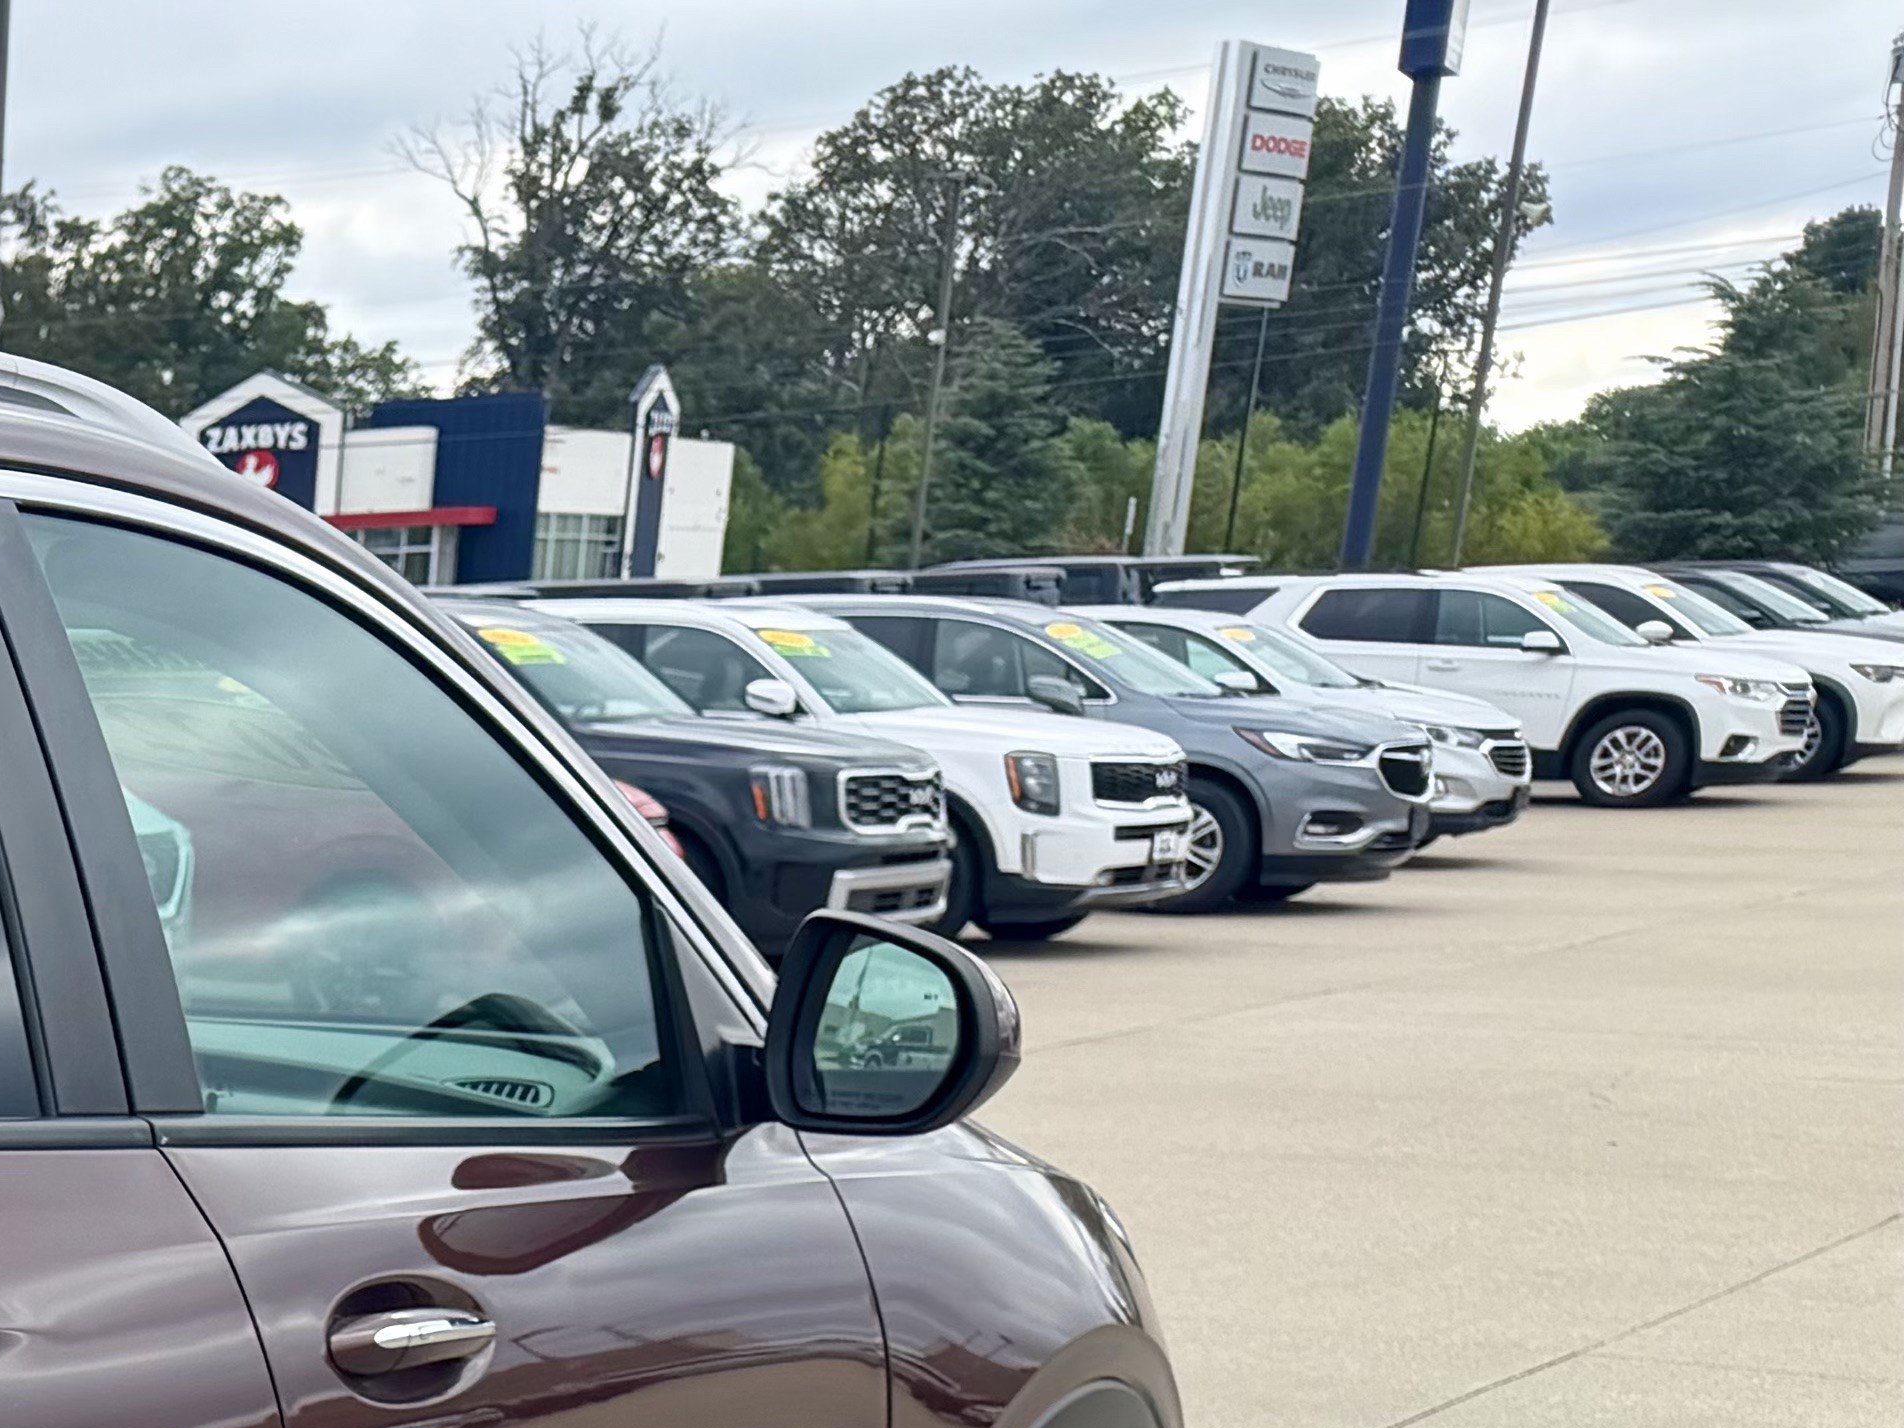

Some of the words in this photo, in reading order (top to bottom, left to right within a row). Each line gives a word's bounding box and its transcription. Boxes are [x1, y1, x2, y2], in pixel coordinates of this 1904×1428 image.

[1263, 63, 1317, 81] CHRYSLER
[1251, 134, 1308, 158] DODGE
[1252, 185, 1293, 230] Jeep
[205, 421, 309, 454] ZAXBYS
